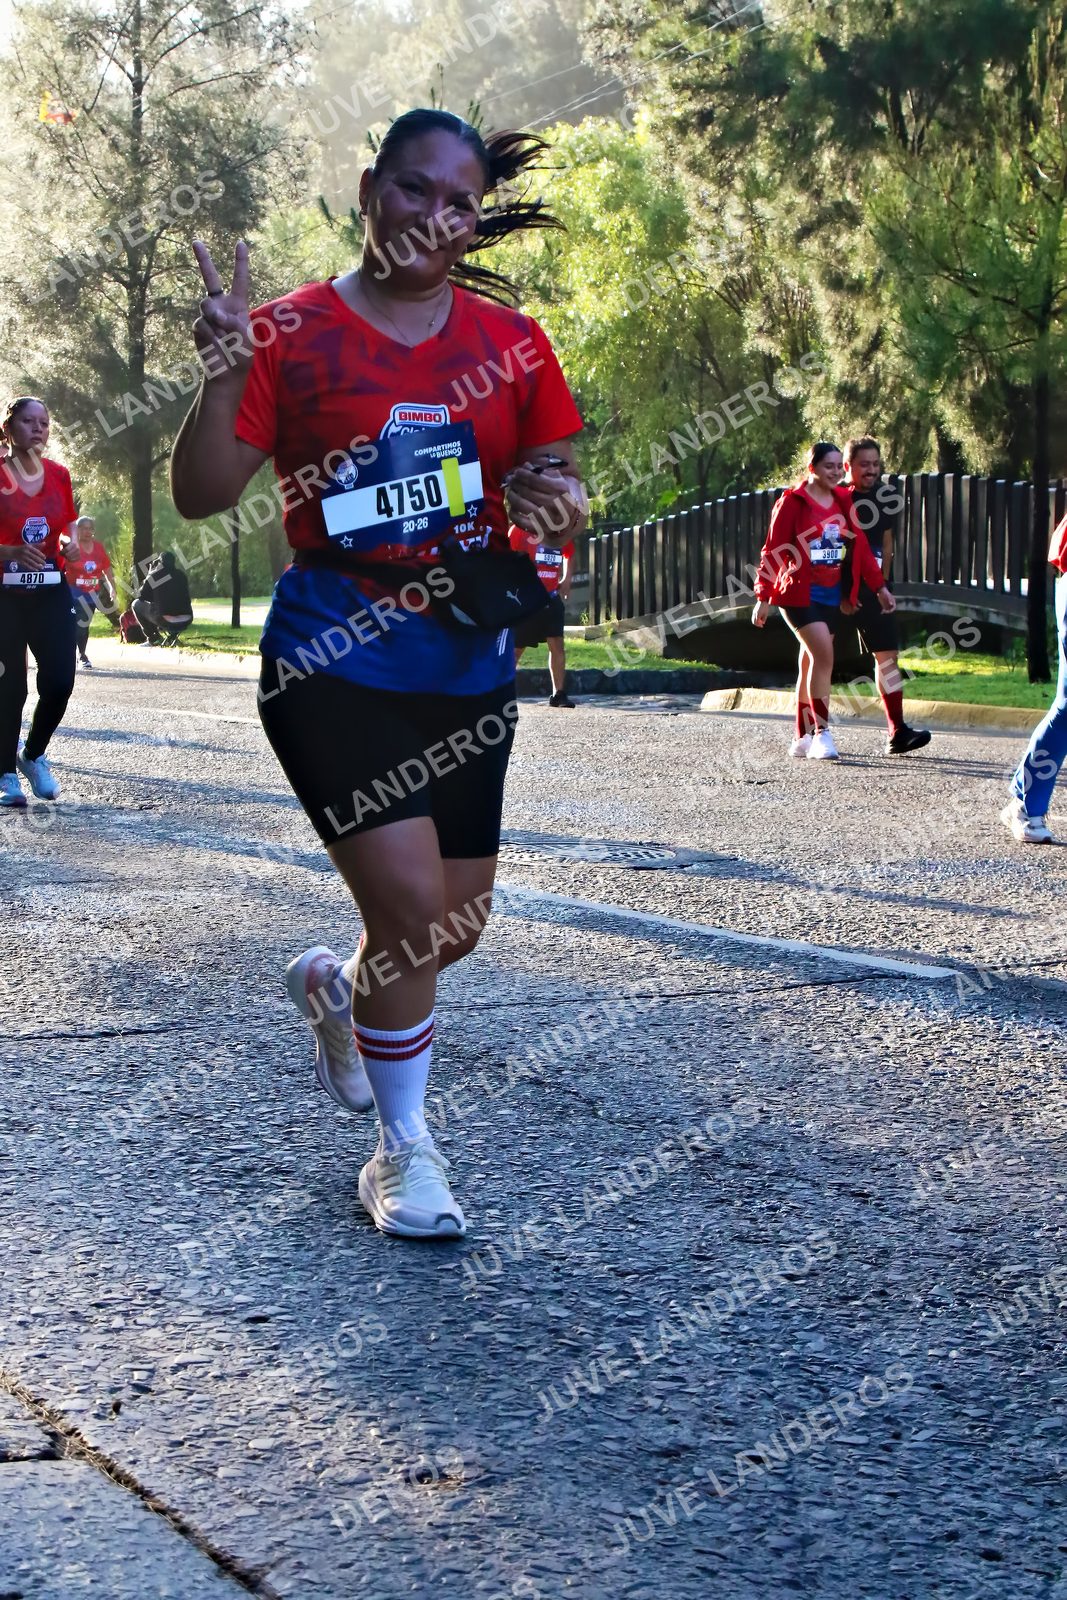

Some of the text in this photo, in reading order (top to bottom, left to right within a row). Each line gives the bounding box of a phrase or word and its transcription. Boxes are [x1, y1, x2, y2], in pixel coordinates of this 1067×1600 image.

[398, 410, 442, 422] BIMBO
[414, 440, 461, 456] COMPARTIMOS
[376, 474, 443, 519] 4750
[453, 521, 475, 534] 10K
[20, 573, 45, 584] 4870
